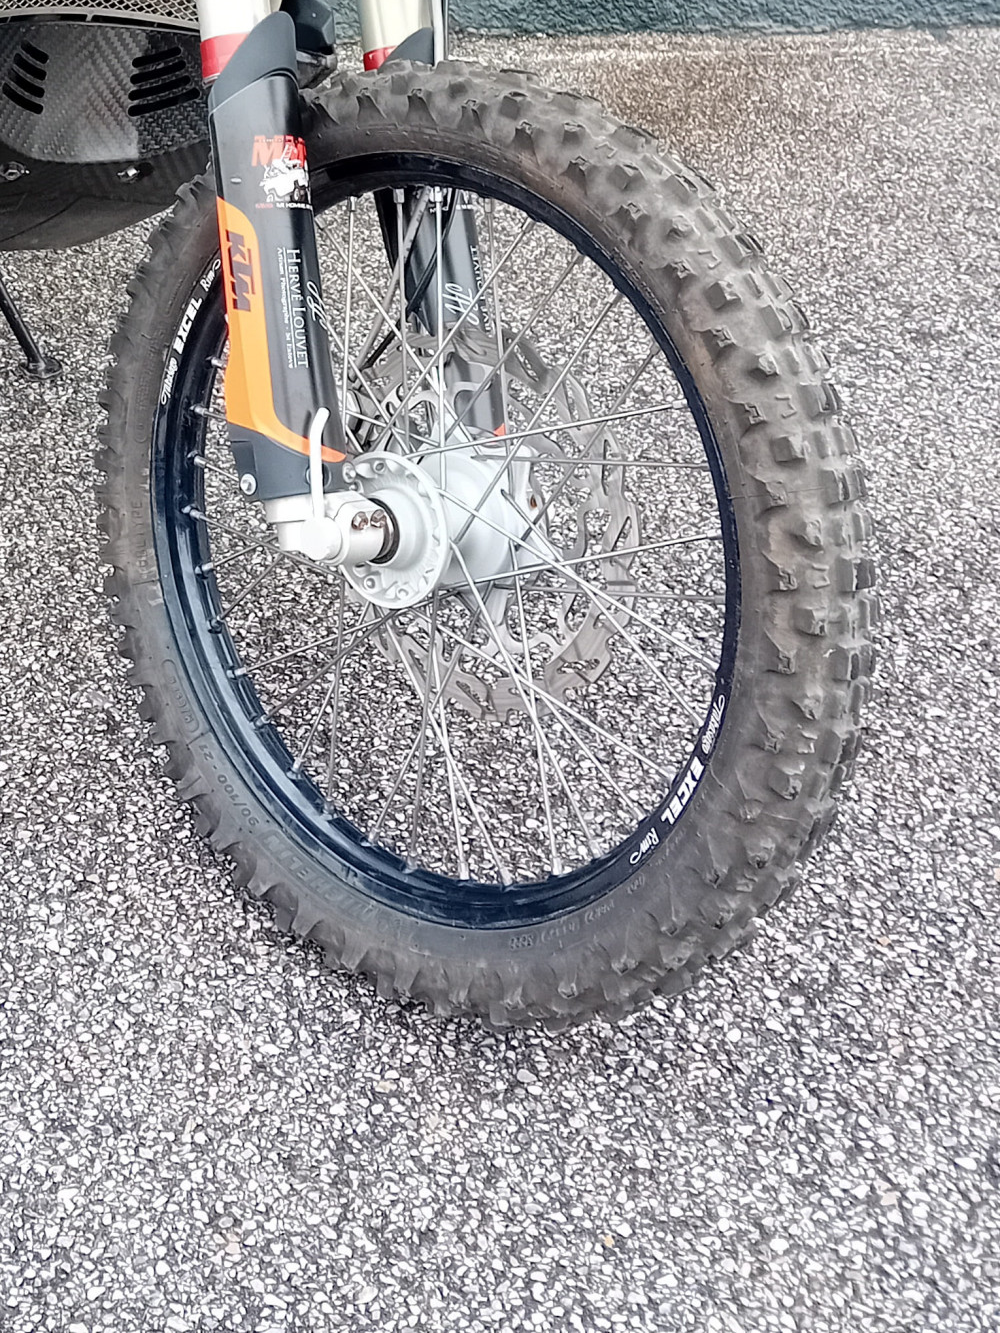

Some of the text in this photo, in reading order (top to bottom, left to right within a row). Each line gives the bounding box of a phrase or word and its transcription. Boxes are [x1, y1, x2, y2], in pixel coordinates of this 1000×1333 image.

[225, 229, 256, 313] KTM
[173, 297, 203, 355] EXCEL
[292, 307, 309, 369] LOUVET
[660, 756, 705, 826] EXCEL
